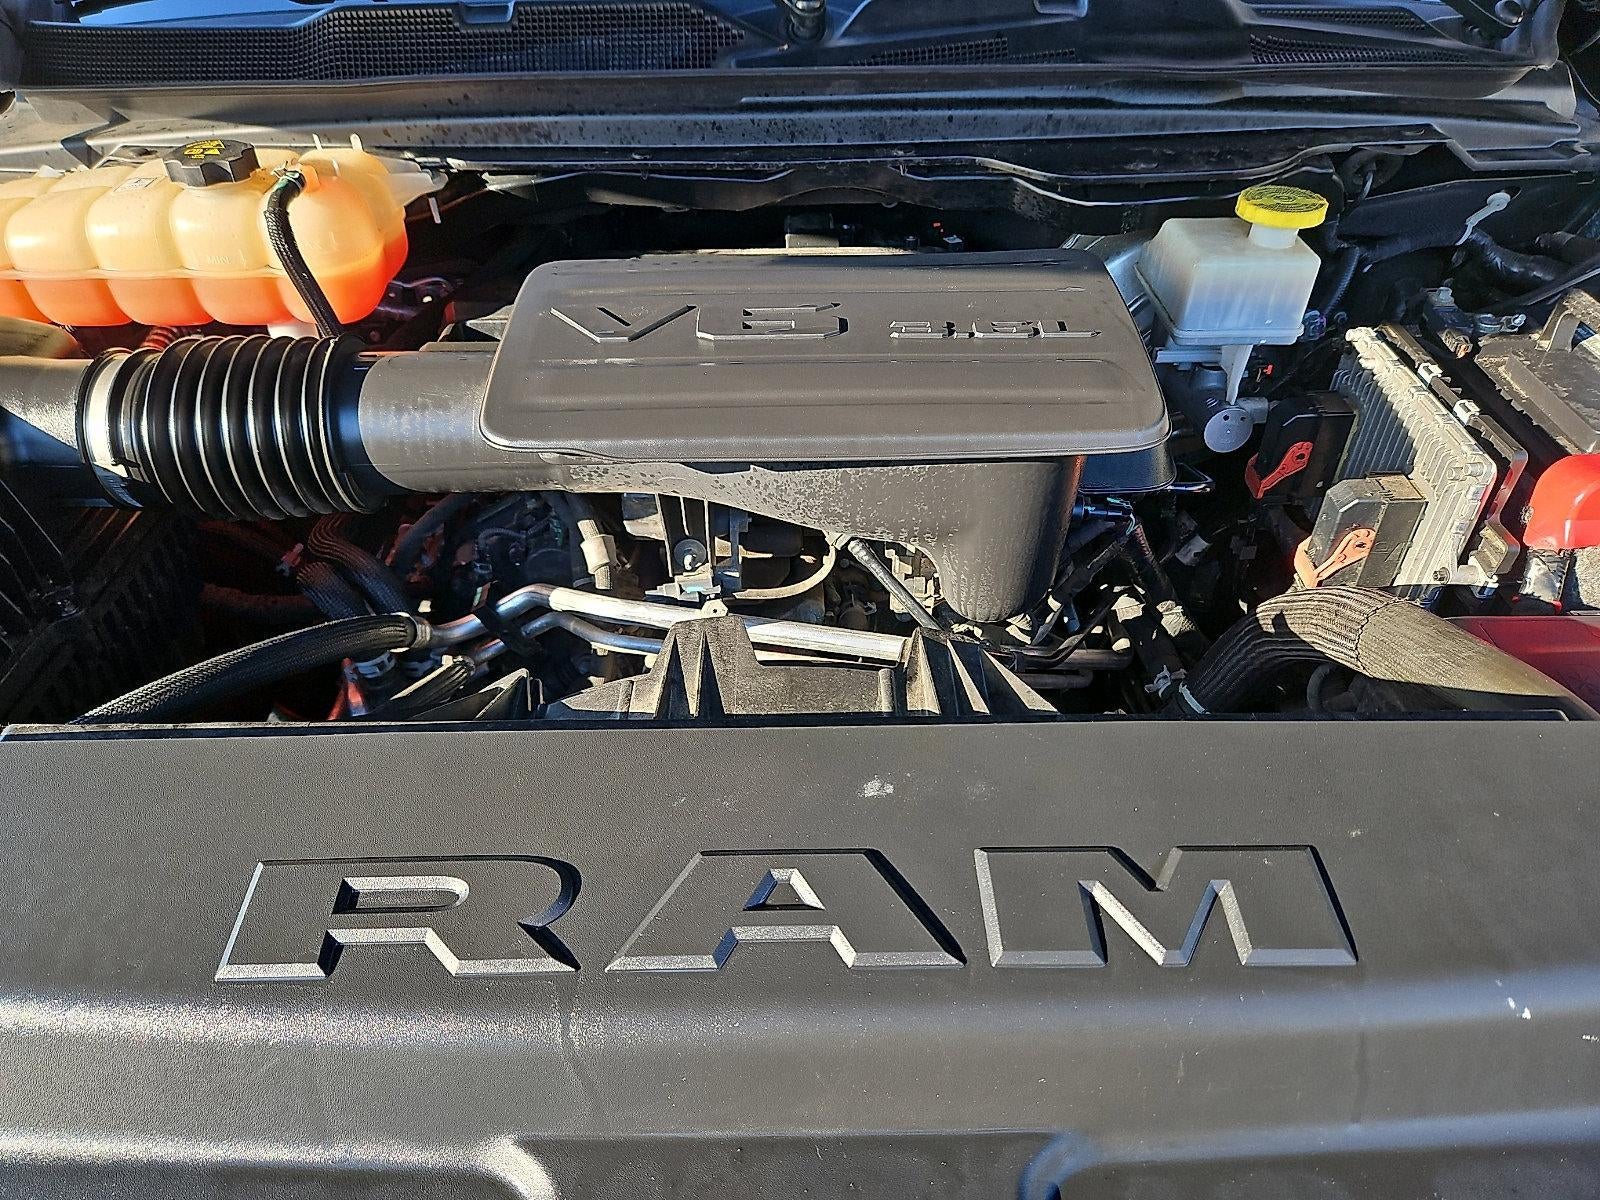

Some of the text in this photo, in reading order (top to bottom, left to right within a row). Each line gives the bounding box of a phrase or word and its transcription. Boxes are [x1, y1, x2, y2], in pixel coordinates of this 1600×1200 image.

[550, 302, 1102, 343] V6 3.6L
[215, 845, 1360, 982] RAM
